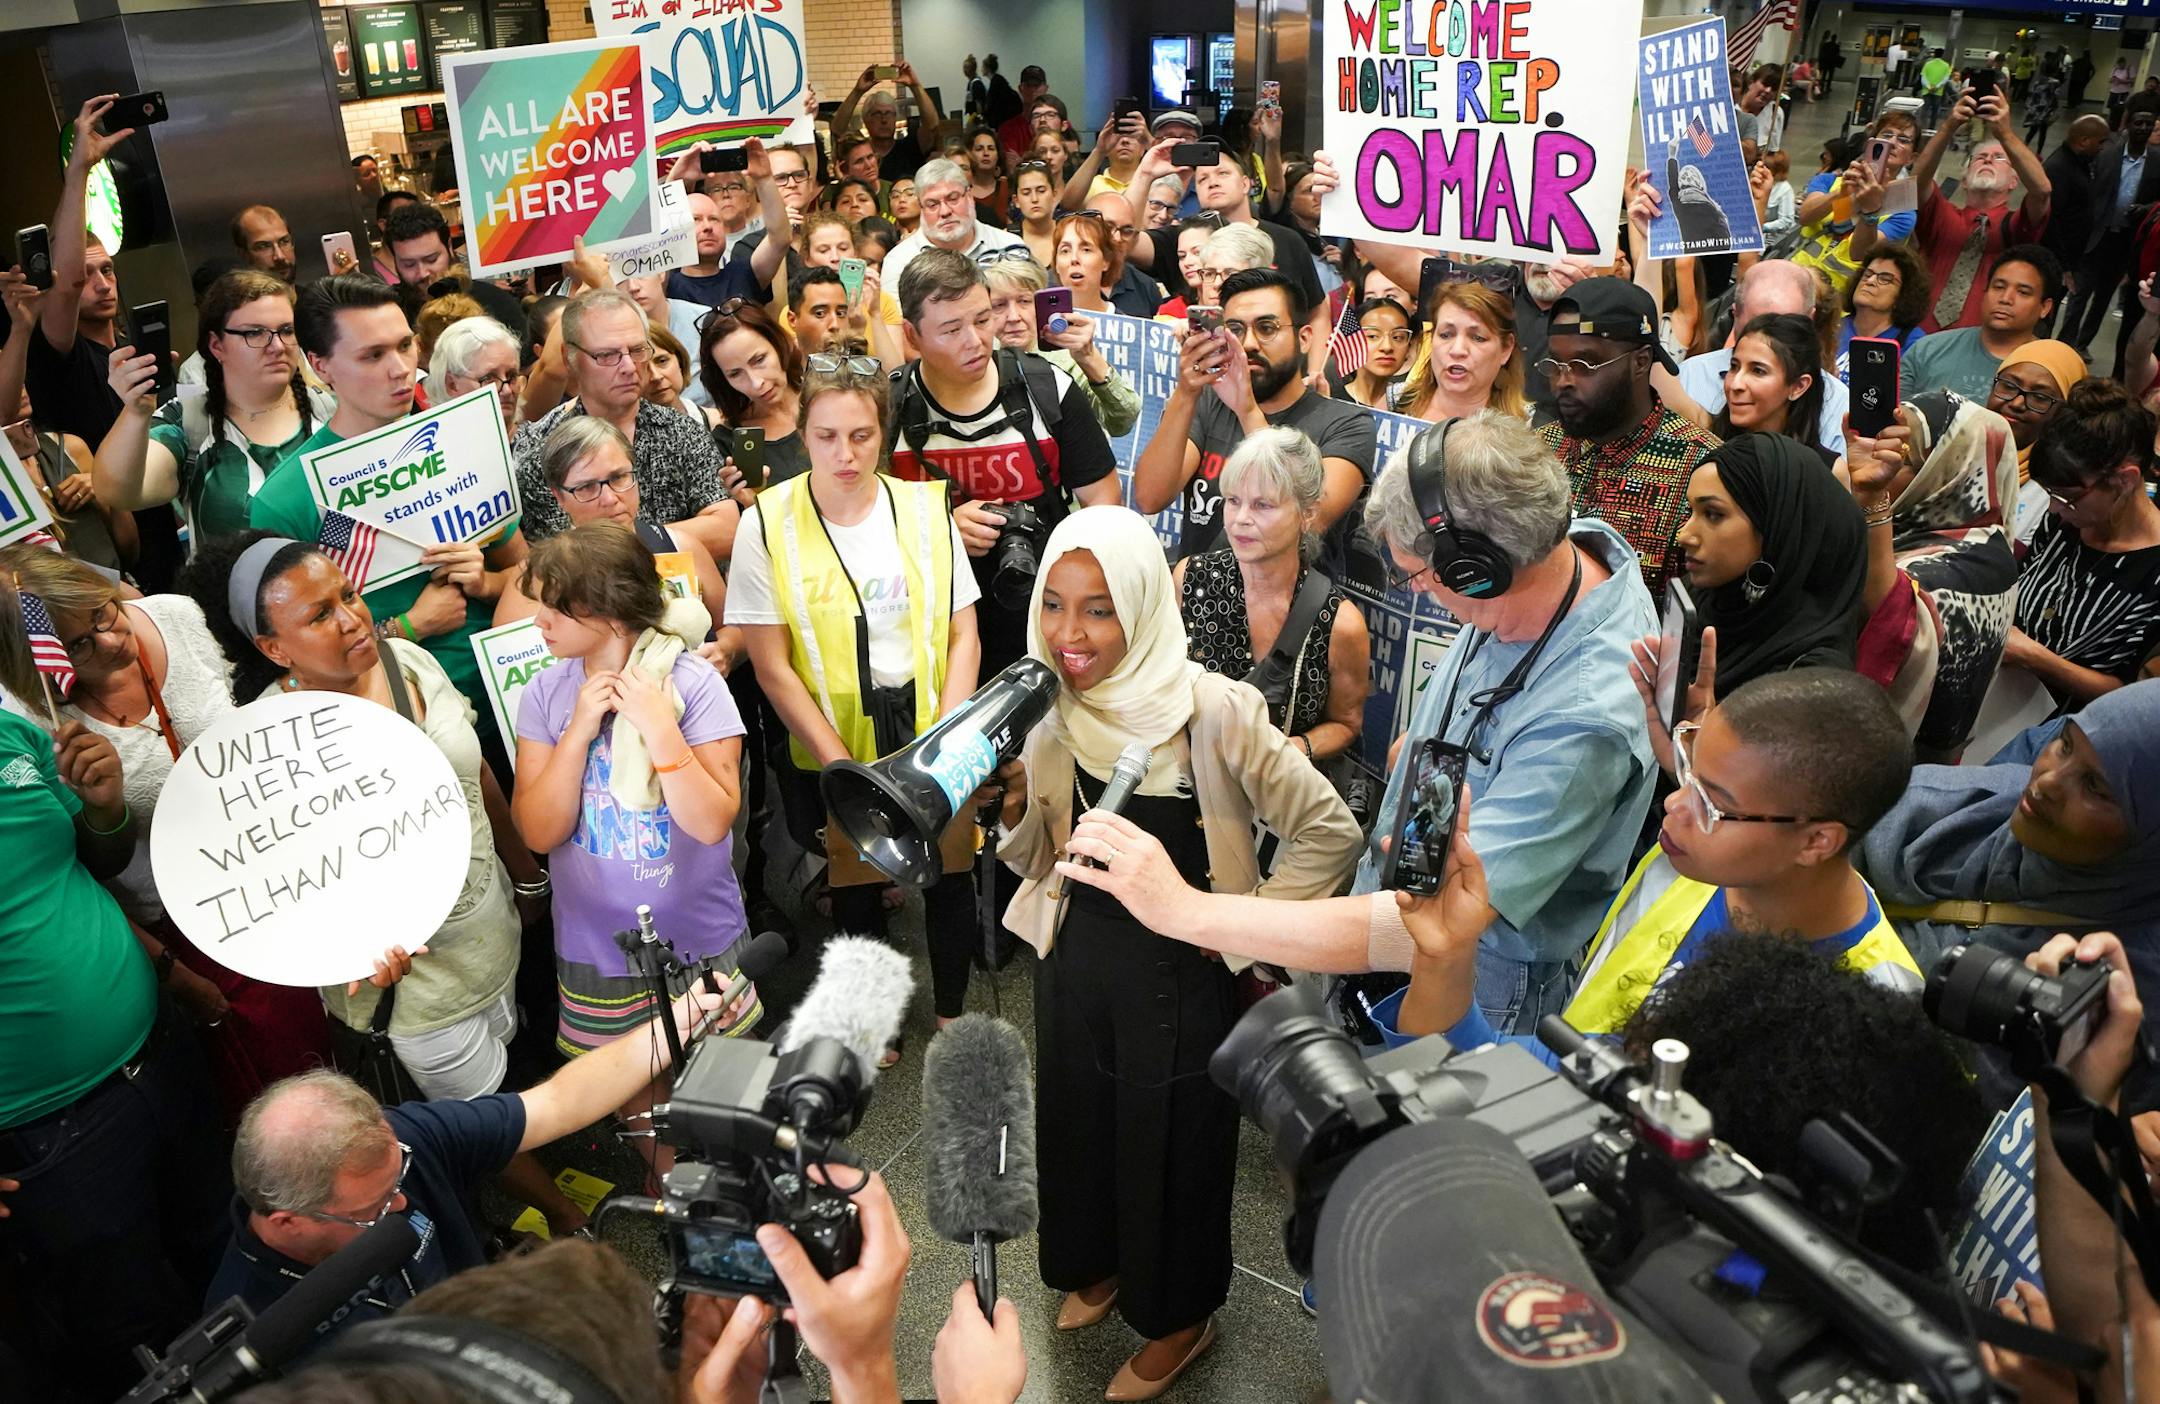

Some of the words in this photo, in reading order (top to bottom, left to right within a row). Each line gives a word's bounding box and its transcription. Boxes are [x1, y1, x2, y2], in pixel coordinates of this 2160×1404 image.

[1344, 0, 1532, 60] WELCOME
[1644, 28, 1719, 75] STAND
[1338, 56, 1438, 119] HOME
[1457, 58, 1564, 128] REP.
[1651, 66, 1715, 107] WITH
[478, 100, 549, 142] ALL
[558, 87, 633, 130] ARE
[1647, 102, 1729, 144] ILHAN
[480, 131, 635, 180] WELCOME
[485, 174, 598, 226] HERE
[1355, 128, 1600, 255] OMAR
[621, 249, 674, 276] OMAR
[329, 464, 376, 487] Council
[378, 459, 387, 469] 5
[336, 450, 447, 511] AFSCME
[384, 490, 443, 524] stands
[445, 472, 479, 498] with
[919, 451, 1024, 496] UESS
[431, 489, 511, 544] Ilhan
[497, 644, 543, 665] Council
[194, 704, 352, 778] UNITE
[219, 743, 352, 821] HERE
[199, 768, 396, 871] WELCOMES
[196, 846, 342, 942] ILHAN
[631, 862, 676, 888] things
